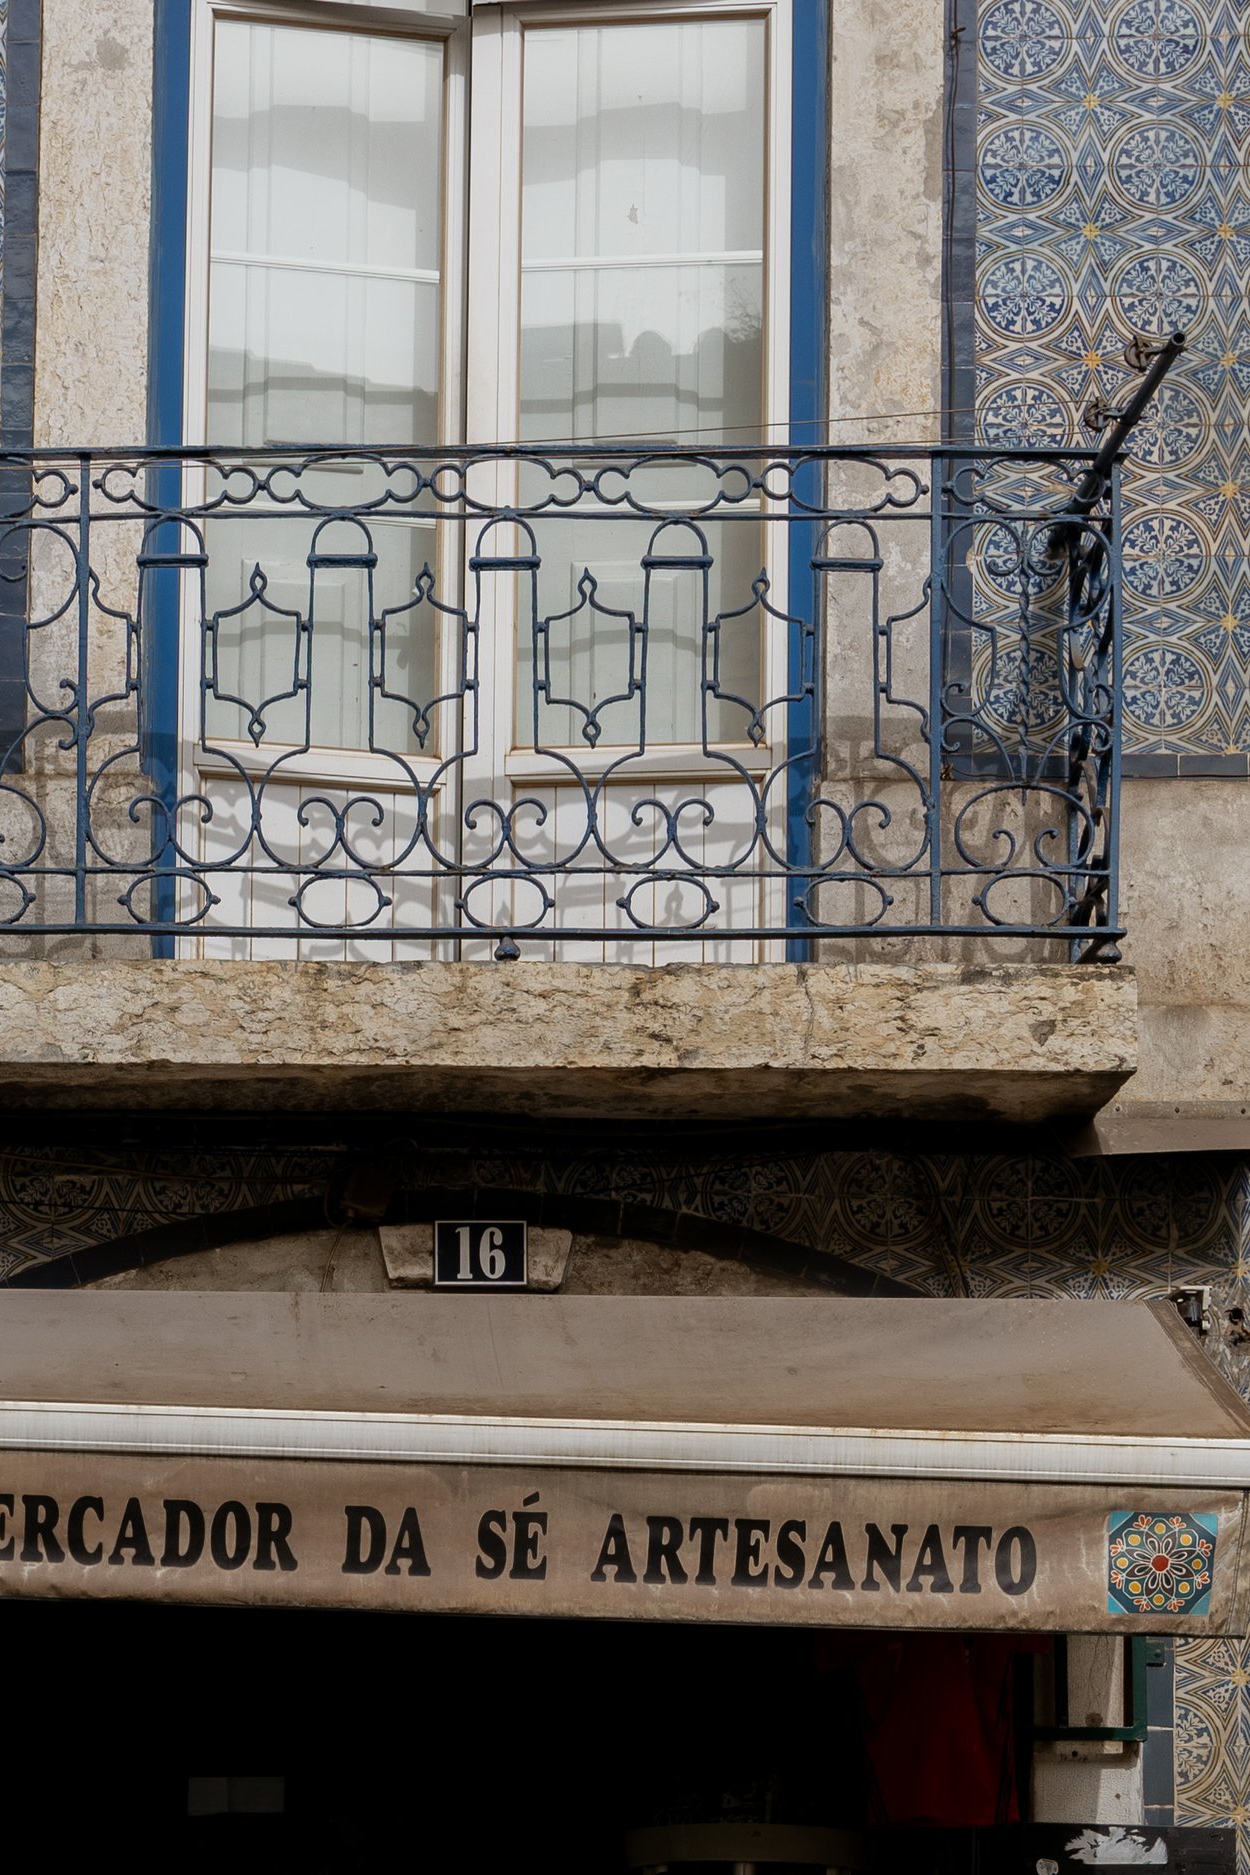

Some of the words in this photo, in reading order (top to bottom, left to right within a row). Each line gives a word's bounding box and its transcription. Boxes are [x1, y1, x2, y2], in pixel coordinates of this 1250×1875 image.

[455, 1226, 506, 1279] 16
[341, 1504, 431, 1577] DA
[475, 1491, 548, 1581] SÉ
[590, 1513, 1038, 1596] ARTESANATO
